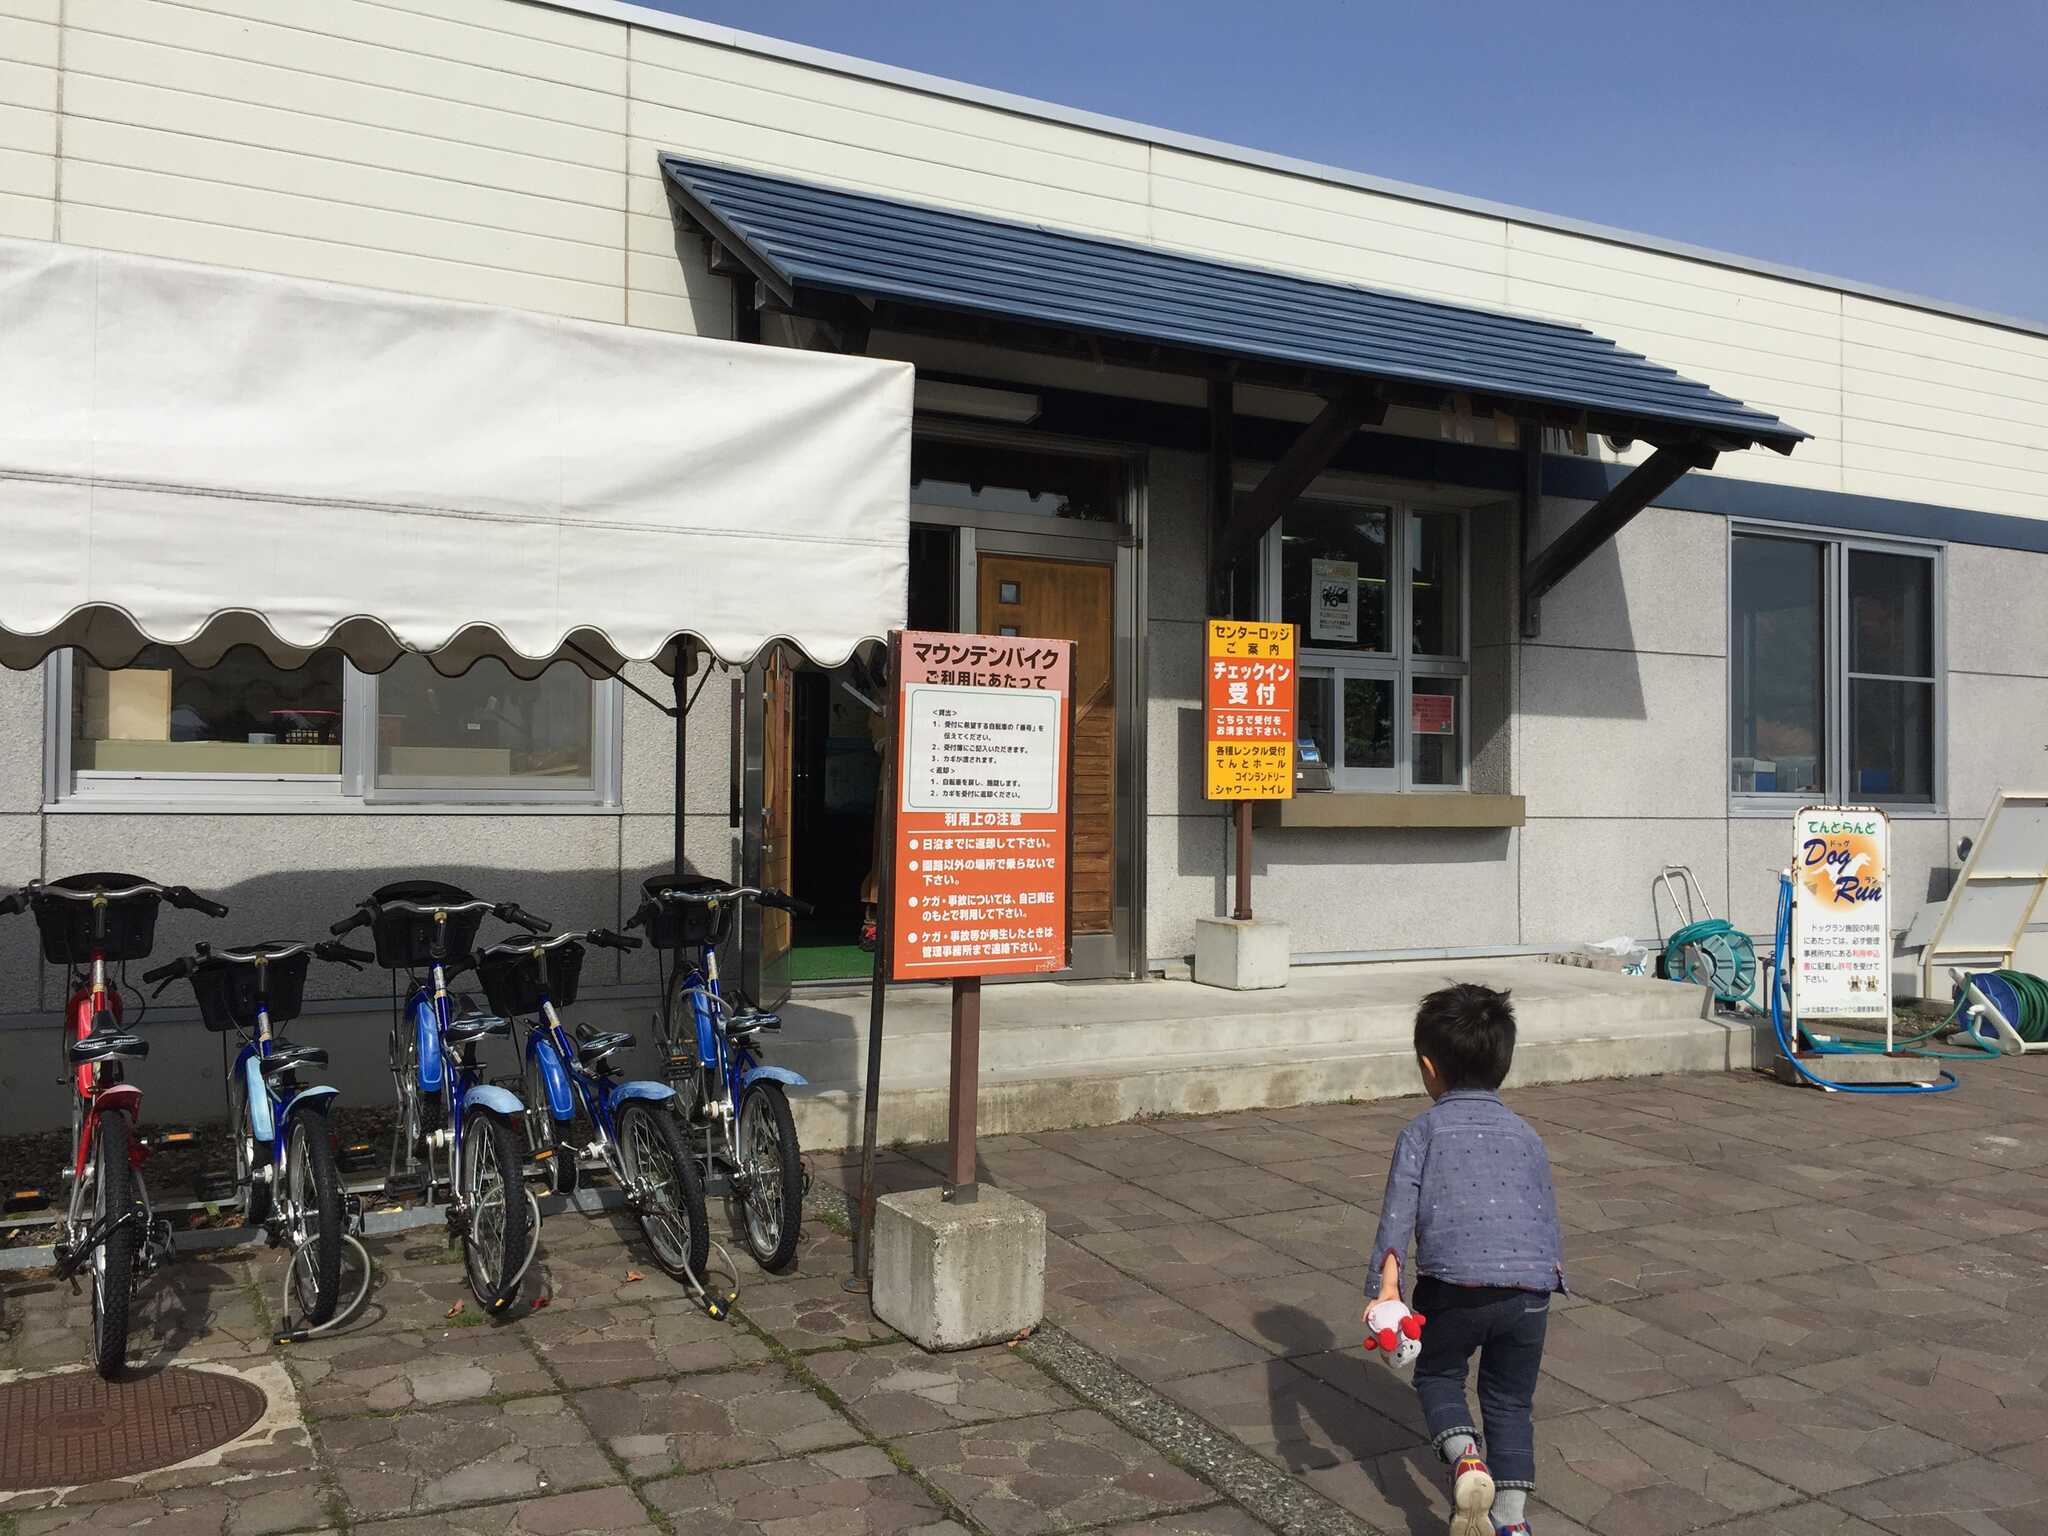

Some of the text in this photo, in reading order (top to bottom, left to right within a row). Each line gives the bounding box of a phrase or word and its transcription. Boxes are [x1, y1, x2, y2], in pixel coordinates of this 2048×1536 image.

[1215, 625, 1290, 640] センターロッジ
[1226, 642, 1280, 656] ご案内
[912, 643, 1060, 670] マウンテンバイク
[1213, 661, 1291, 682] チェックイン
[925, 670, 1048, 690] ご利用にあたって
[1228, 682, 1276, 706] 受付
[1216, 714, 1281, 726] こちらで受付を
[1216, 726, 1287, 737] お済ませ下さい。
[1215, 746, 1286, 757] 各種レンタル受付
[1216, 759, 1286, 769] てんとホール
[1235, 772, 1286, 782] コインランドリー
[1215, 784, 1286, 795] シャワー・トイレ
[944, 812, 1023, 827] 利用上の注意
[1803, 838, 1852, 875] Dog
[922, 874, 960, 887] 下さい。
[1834, 876, 1883, 904] Run
[922, 908, 1028, 922] のもとで利用して下さい。
[1804, 976, 1828, 984] 下さい。
